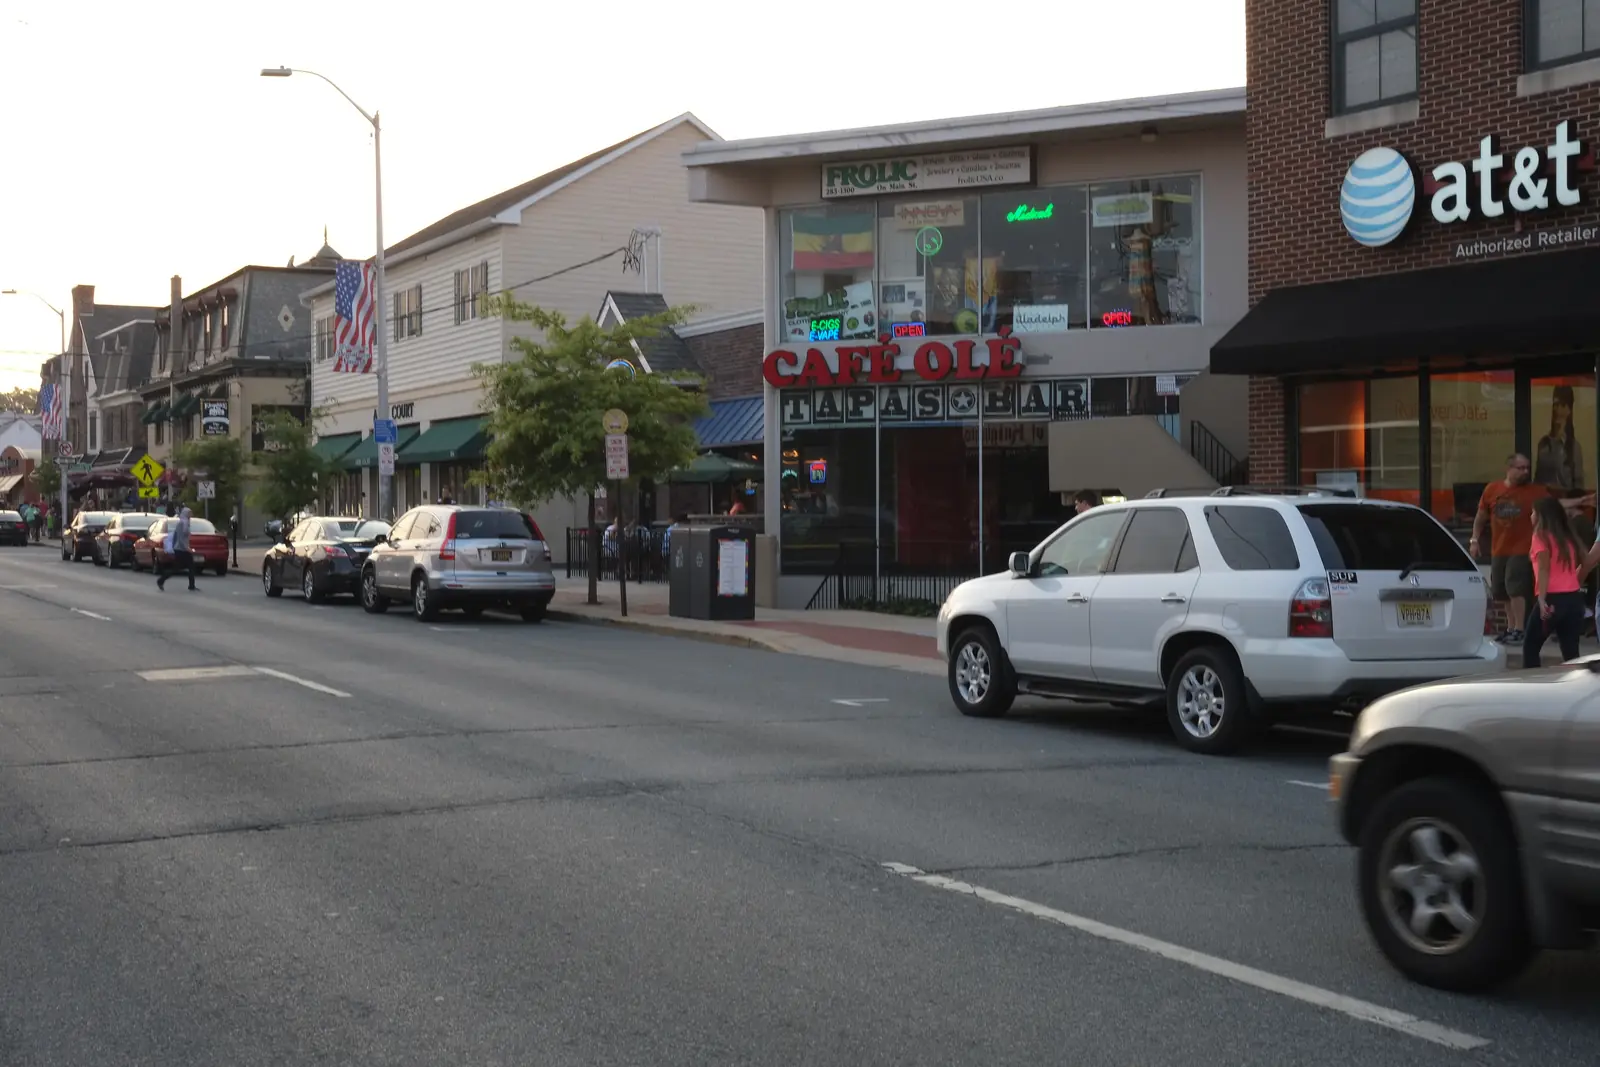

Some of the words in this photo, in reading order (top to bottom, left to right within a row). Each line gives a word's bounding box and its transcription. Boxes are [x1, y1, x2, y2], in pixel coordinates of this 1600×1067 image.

[826, 160, 918, 188] FROLIC
[1456, 234, 1532, 258] Authorized
[1538, 226, 1598, 247] Retailer
[811, 318, 840, 331] E-CIGS
[1103, 312, 1131, 326] OPEN
[809, 329, 840, 342] E-VAPE
[895, 326, 923, 337] OPEN
[763, 334, 901, 387] CAFÉ
[914, 327, 1022, 382] OLÉ
[783, 387, 943, 420] TAPAS
[984, 382, 1087, 415] BAR
[391, 402, 415, 419] COURT
[1456, 401, 1488, 421] Data
